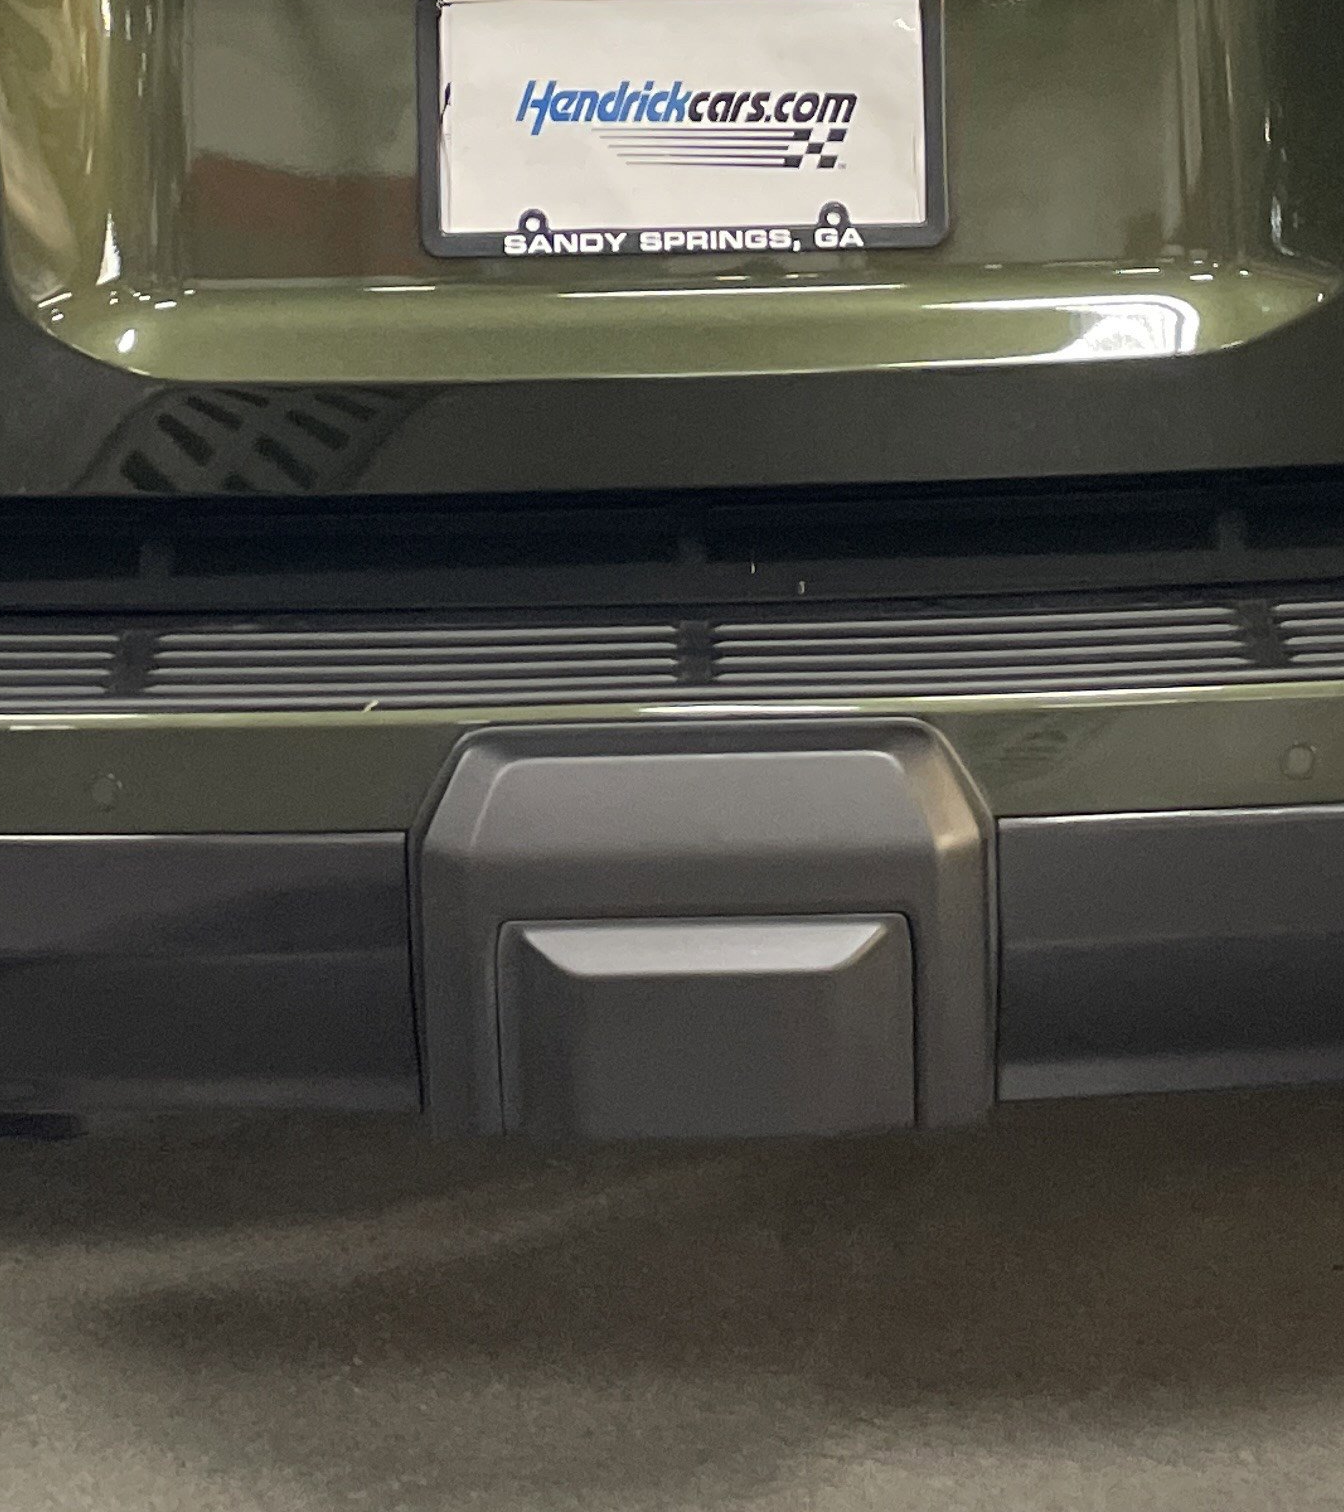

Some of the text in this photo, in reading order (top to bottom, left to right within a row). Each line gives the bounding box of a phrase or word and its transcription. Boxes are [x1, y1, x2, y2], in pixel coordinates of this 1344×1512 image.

[515, 79, 858, 135] Hendrickcars.com
[503, 226, 865, 256] SANDY SPRINGS, GA
